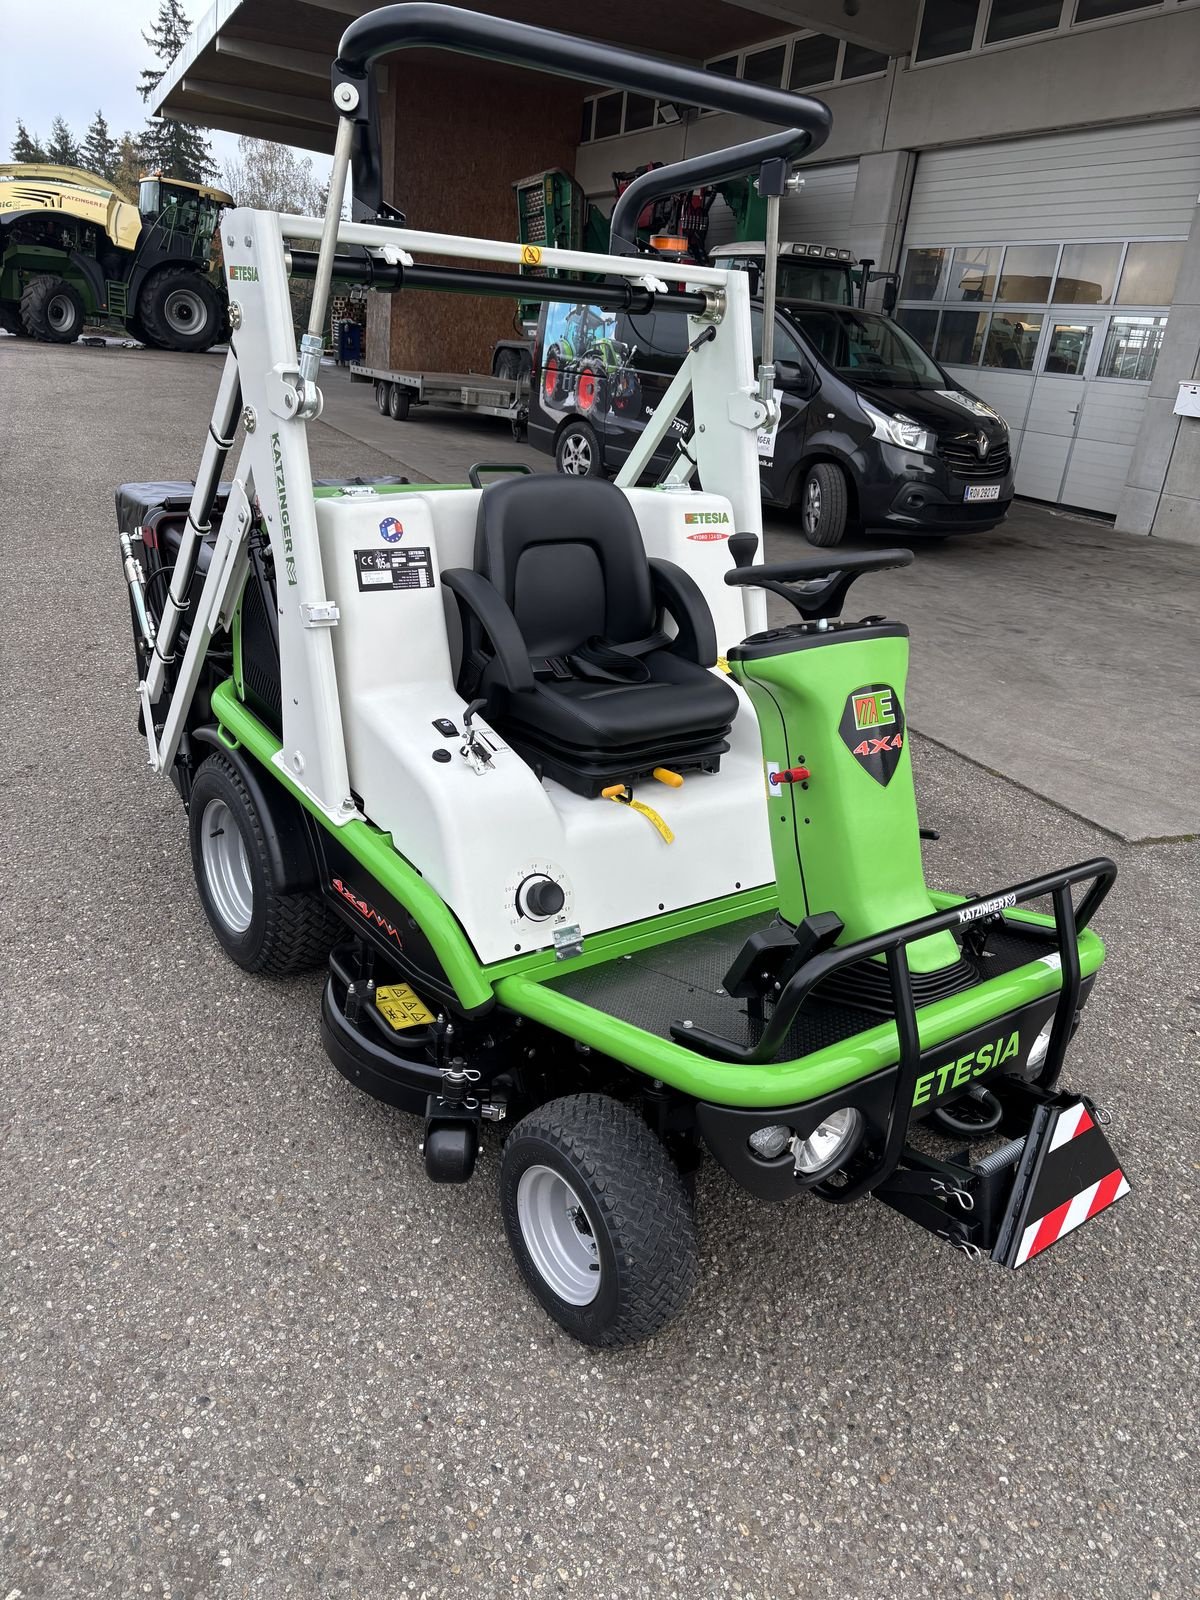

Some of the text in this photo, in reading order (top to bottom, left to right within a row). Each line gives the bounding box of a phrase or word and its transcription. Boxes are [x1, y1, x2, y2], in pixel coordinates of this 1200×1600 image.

[61, 194, 98, 206] KATZINGER
[229, 265, 260, 282] ETESIA
[270, 432, 294, 554] KATZINGER
[684, 512, 730, 524] ETESIA
[958, 898, 1005, 923] KATZINGER
[911, 1030, 1020, 1108] ETESIA
